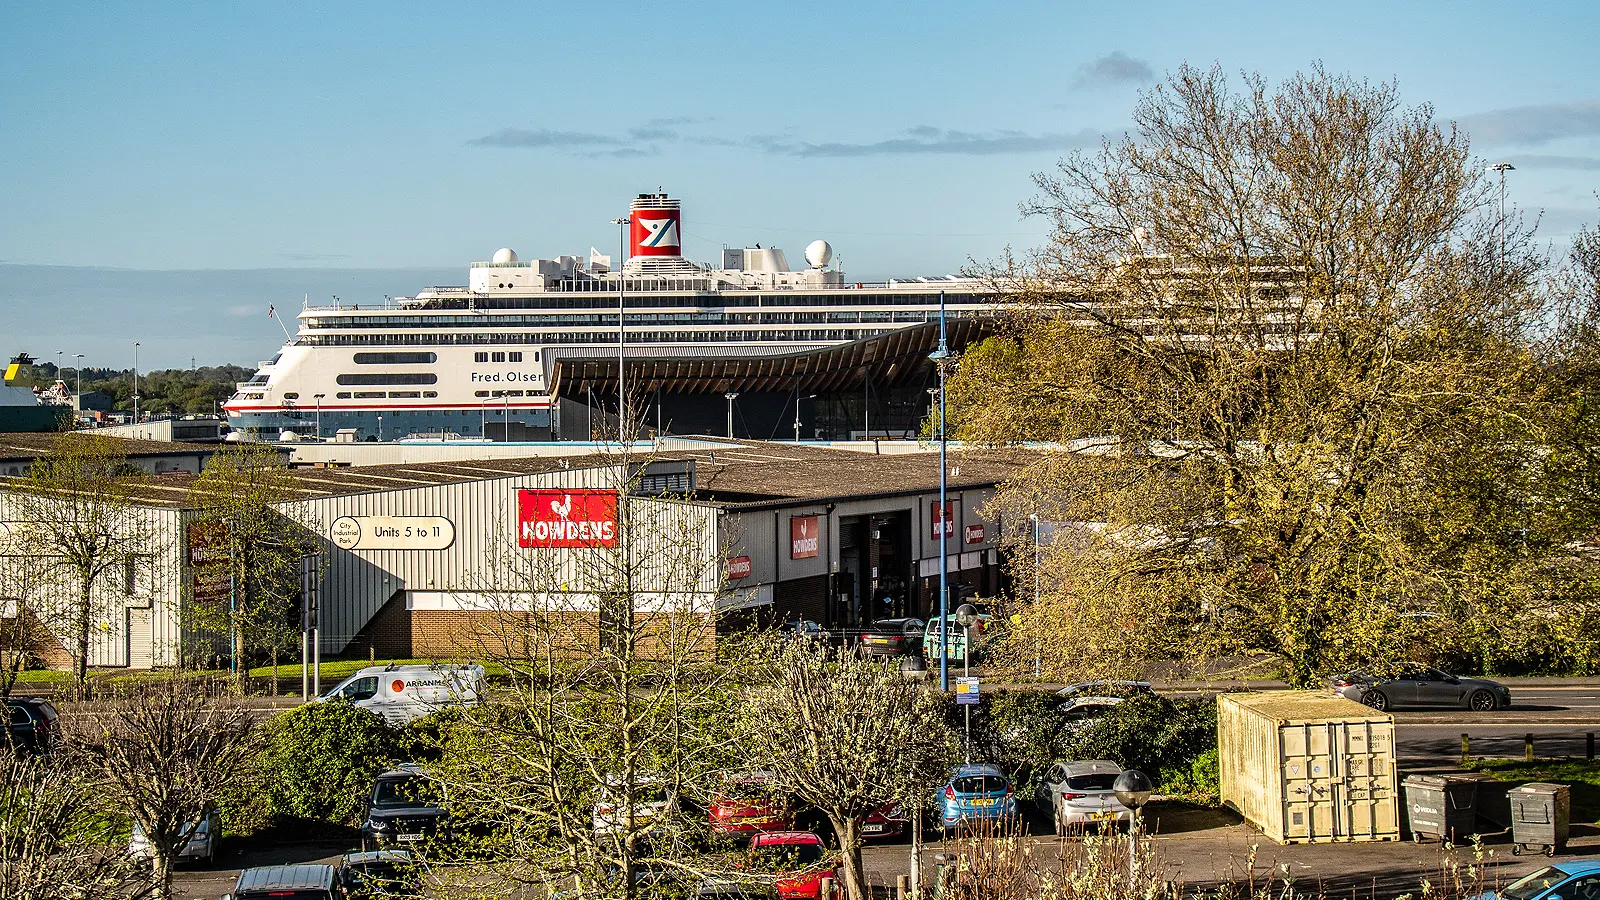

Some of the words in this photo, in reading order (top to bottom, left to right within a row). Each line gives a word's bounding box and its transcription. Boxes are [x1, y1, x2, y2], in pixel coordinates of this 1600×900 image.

[339, 521, 351, 530] City
[522, 521, 614, 540] HOWDENS
[333, 529, 359, 537] Industrial
[374, 526, 400, 538] Units
[405, 526, 412, 538] 5
[417, 527, 428, 538] to
[432, 526, 440, 538] 11
[793, 537, 817, 554] HOWDENS
